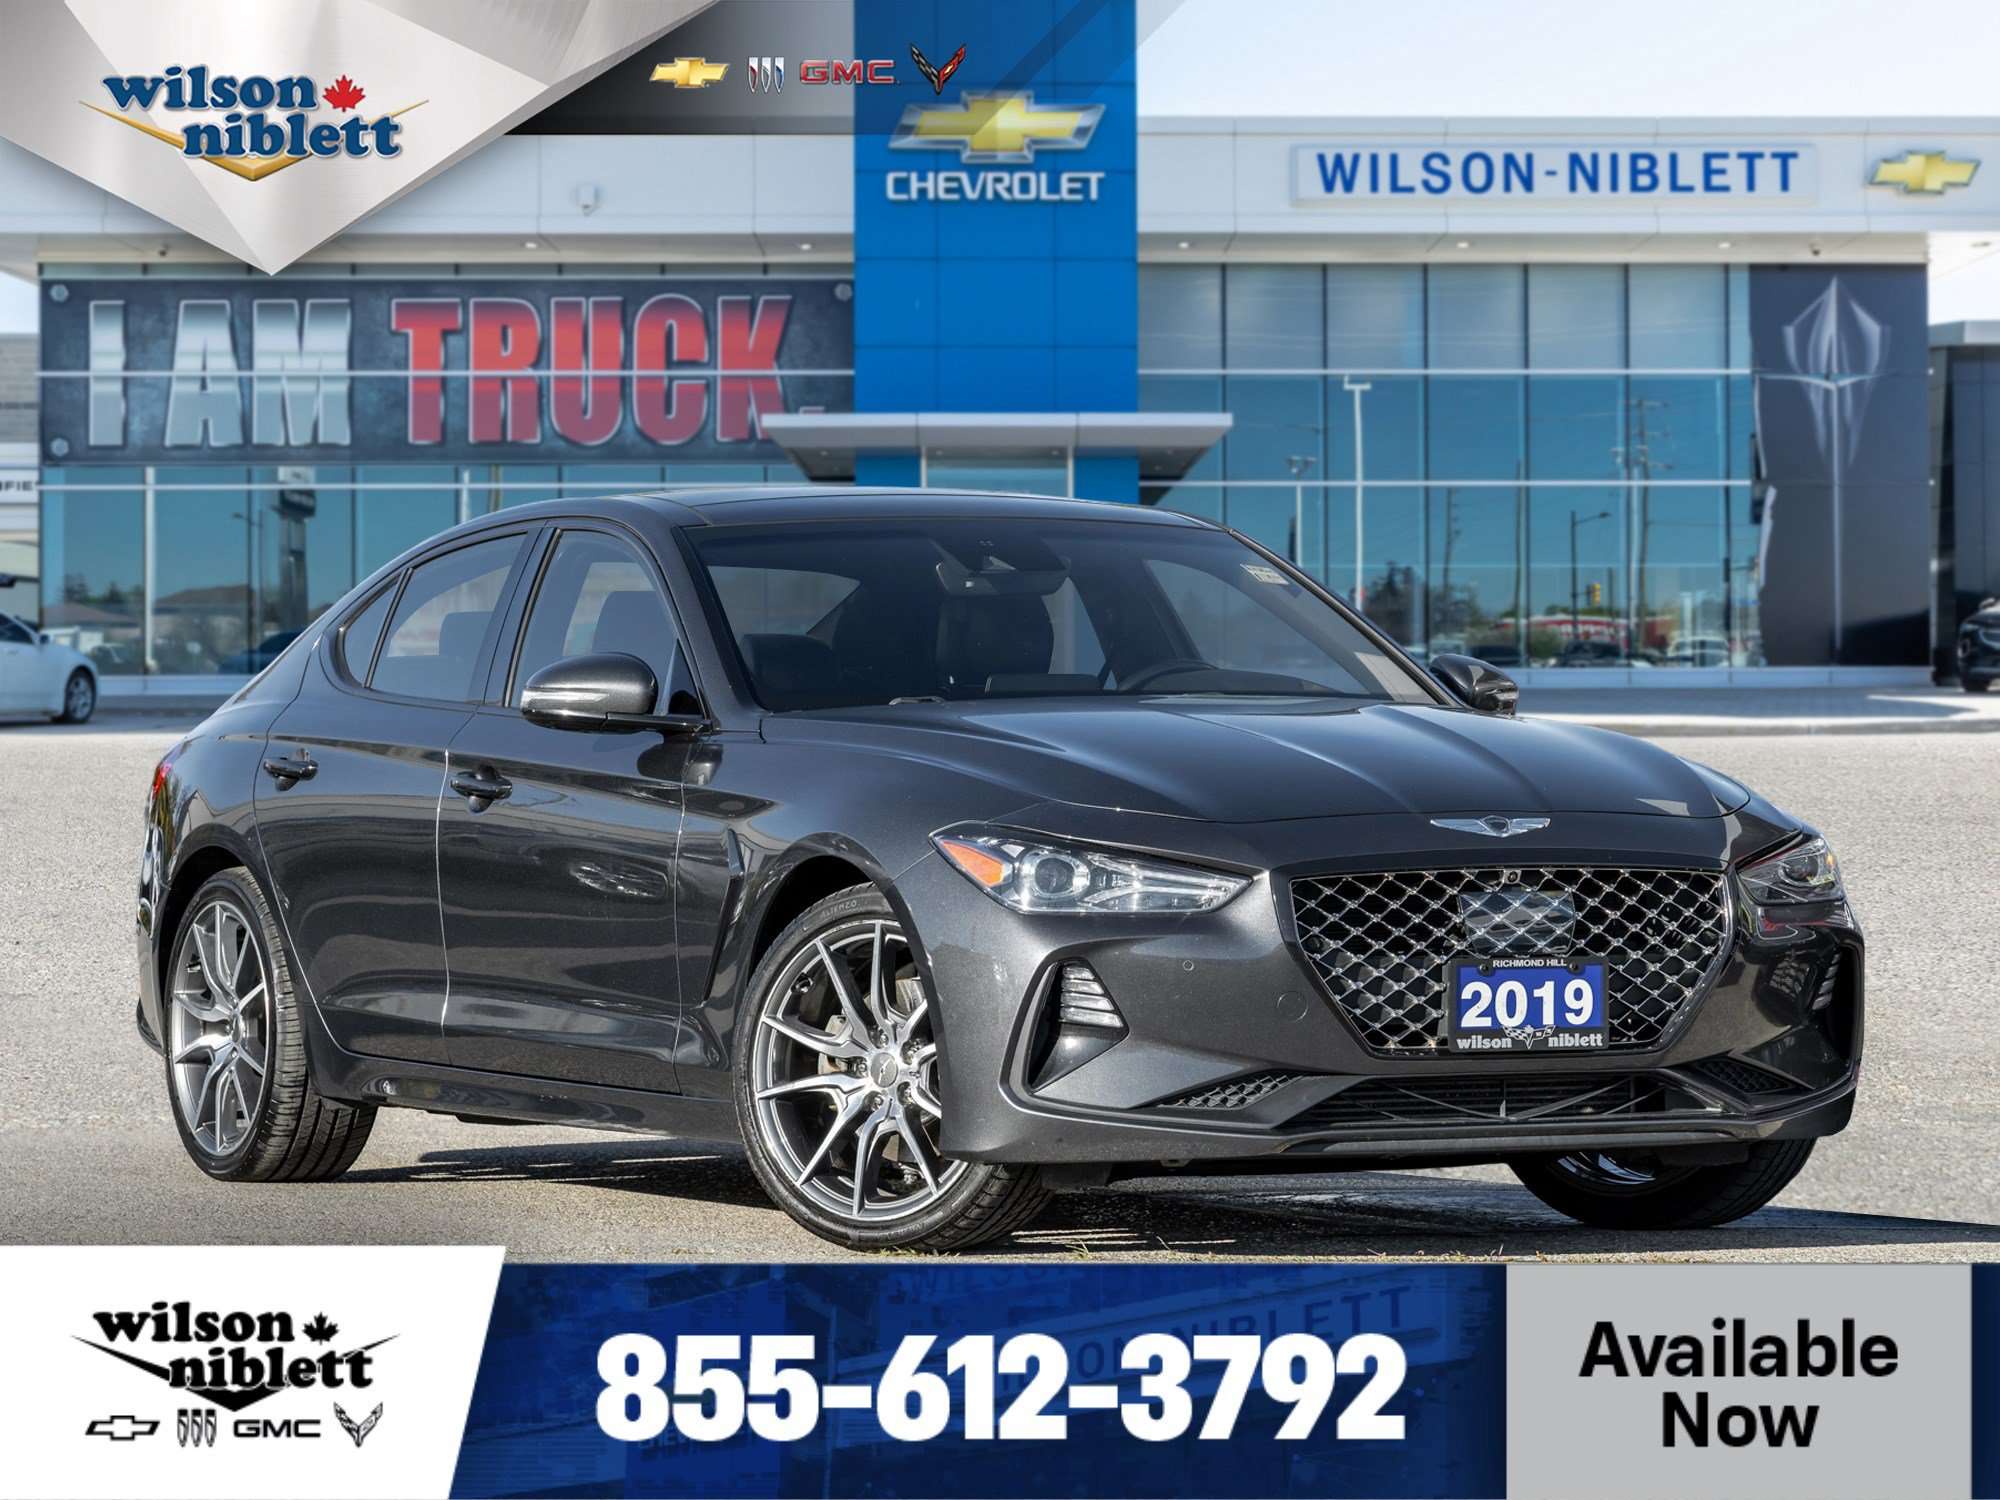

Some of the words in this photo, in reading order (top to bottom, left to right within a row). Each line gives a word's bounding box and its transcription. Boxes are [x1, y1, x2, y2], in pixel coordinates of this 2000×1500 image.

[885, 170, 1105, 203] CHEVROLET
[1315, 150, 1801, 195] WILSON-NIBLETT
[88, 300, 126, 447] I
[164, 299, 352, 447] AM
[391, 294, 792, 446] TRUCK
[1492, 958, 1544, 968] RICHMOND
[1546, 958, 1567, 967] HILL
[1460, 979, 1594, 1028] 2019
[1457, 1035, 1512, 1049] wilson
[1548, 1032, 1603, 1048] niblett
